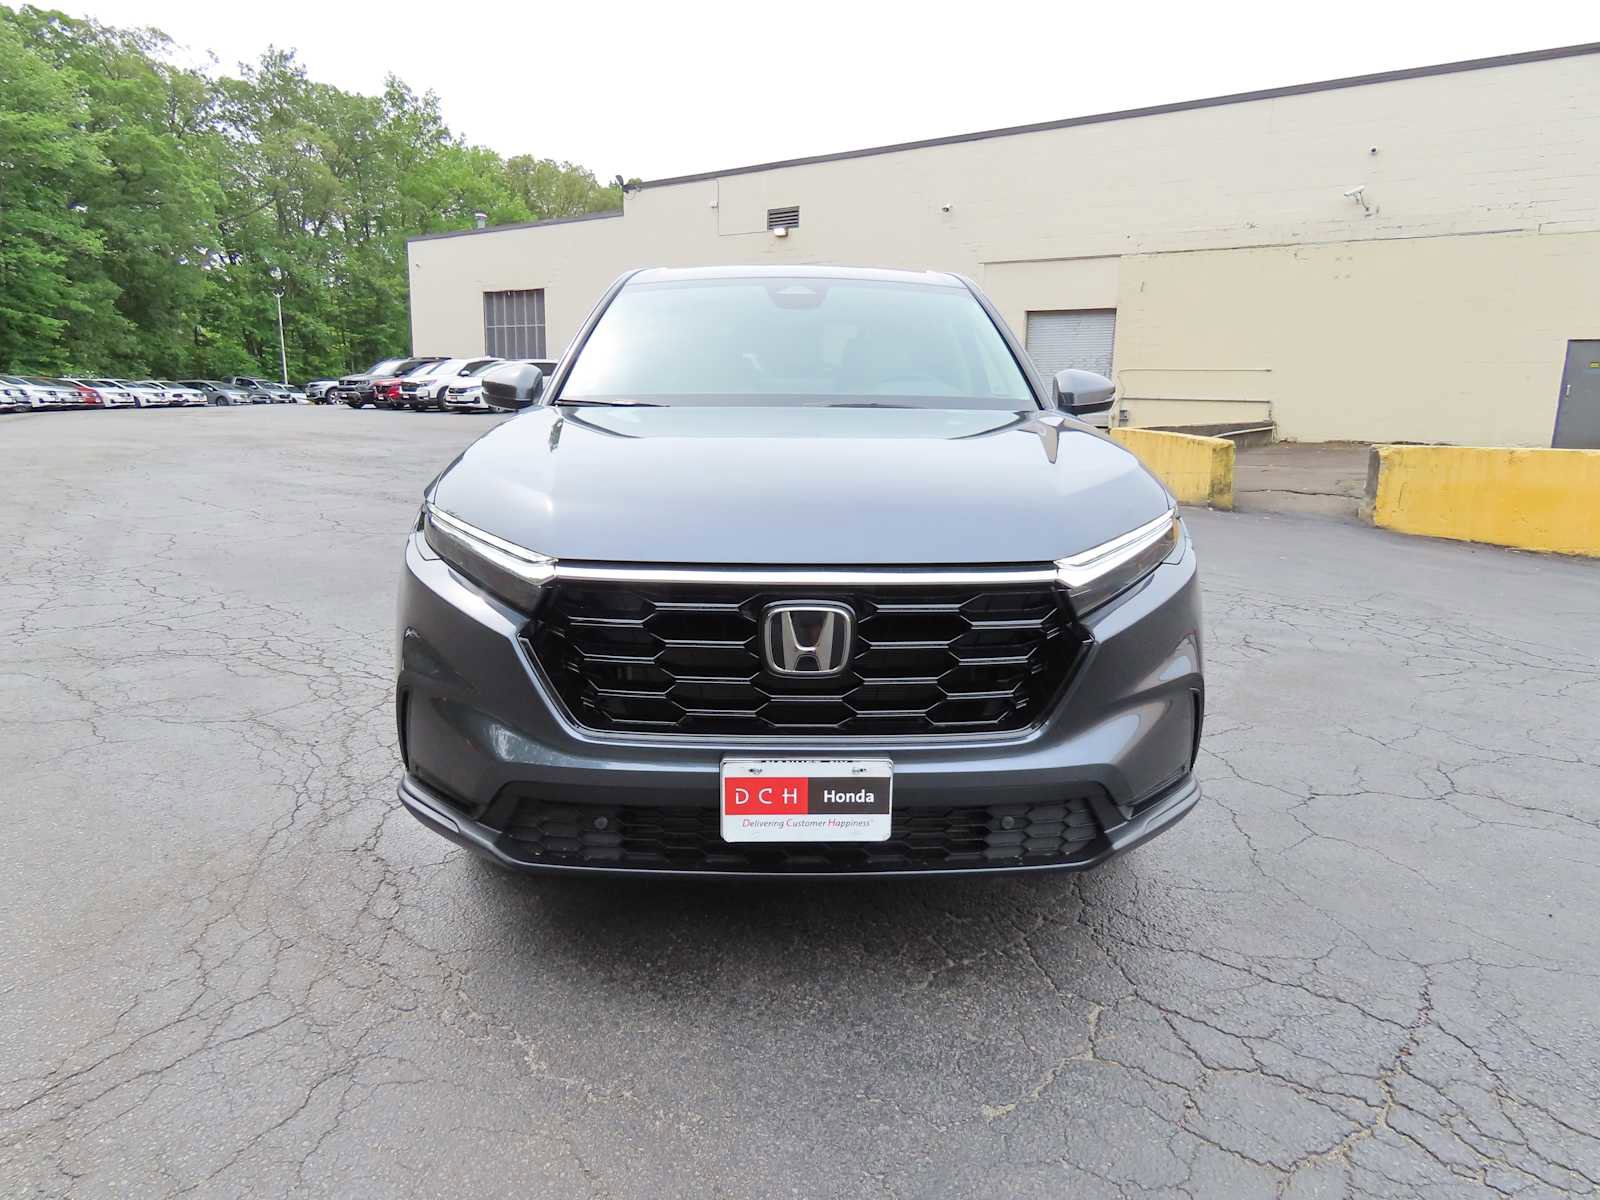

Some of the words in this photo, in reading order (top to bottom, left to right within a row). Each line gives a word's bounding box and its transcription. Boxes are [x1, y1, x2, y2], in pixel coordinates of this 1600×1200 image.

[823, 789, 875, 803] Honda
[742, 818, 784, 829] Delivering
[786, 818, 826, 827] Customer
